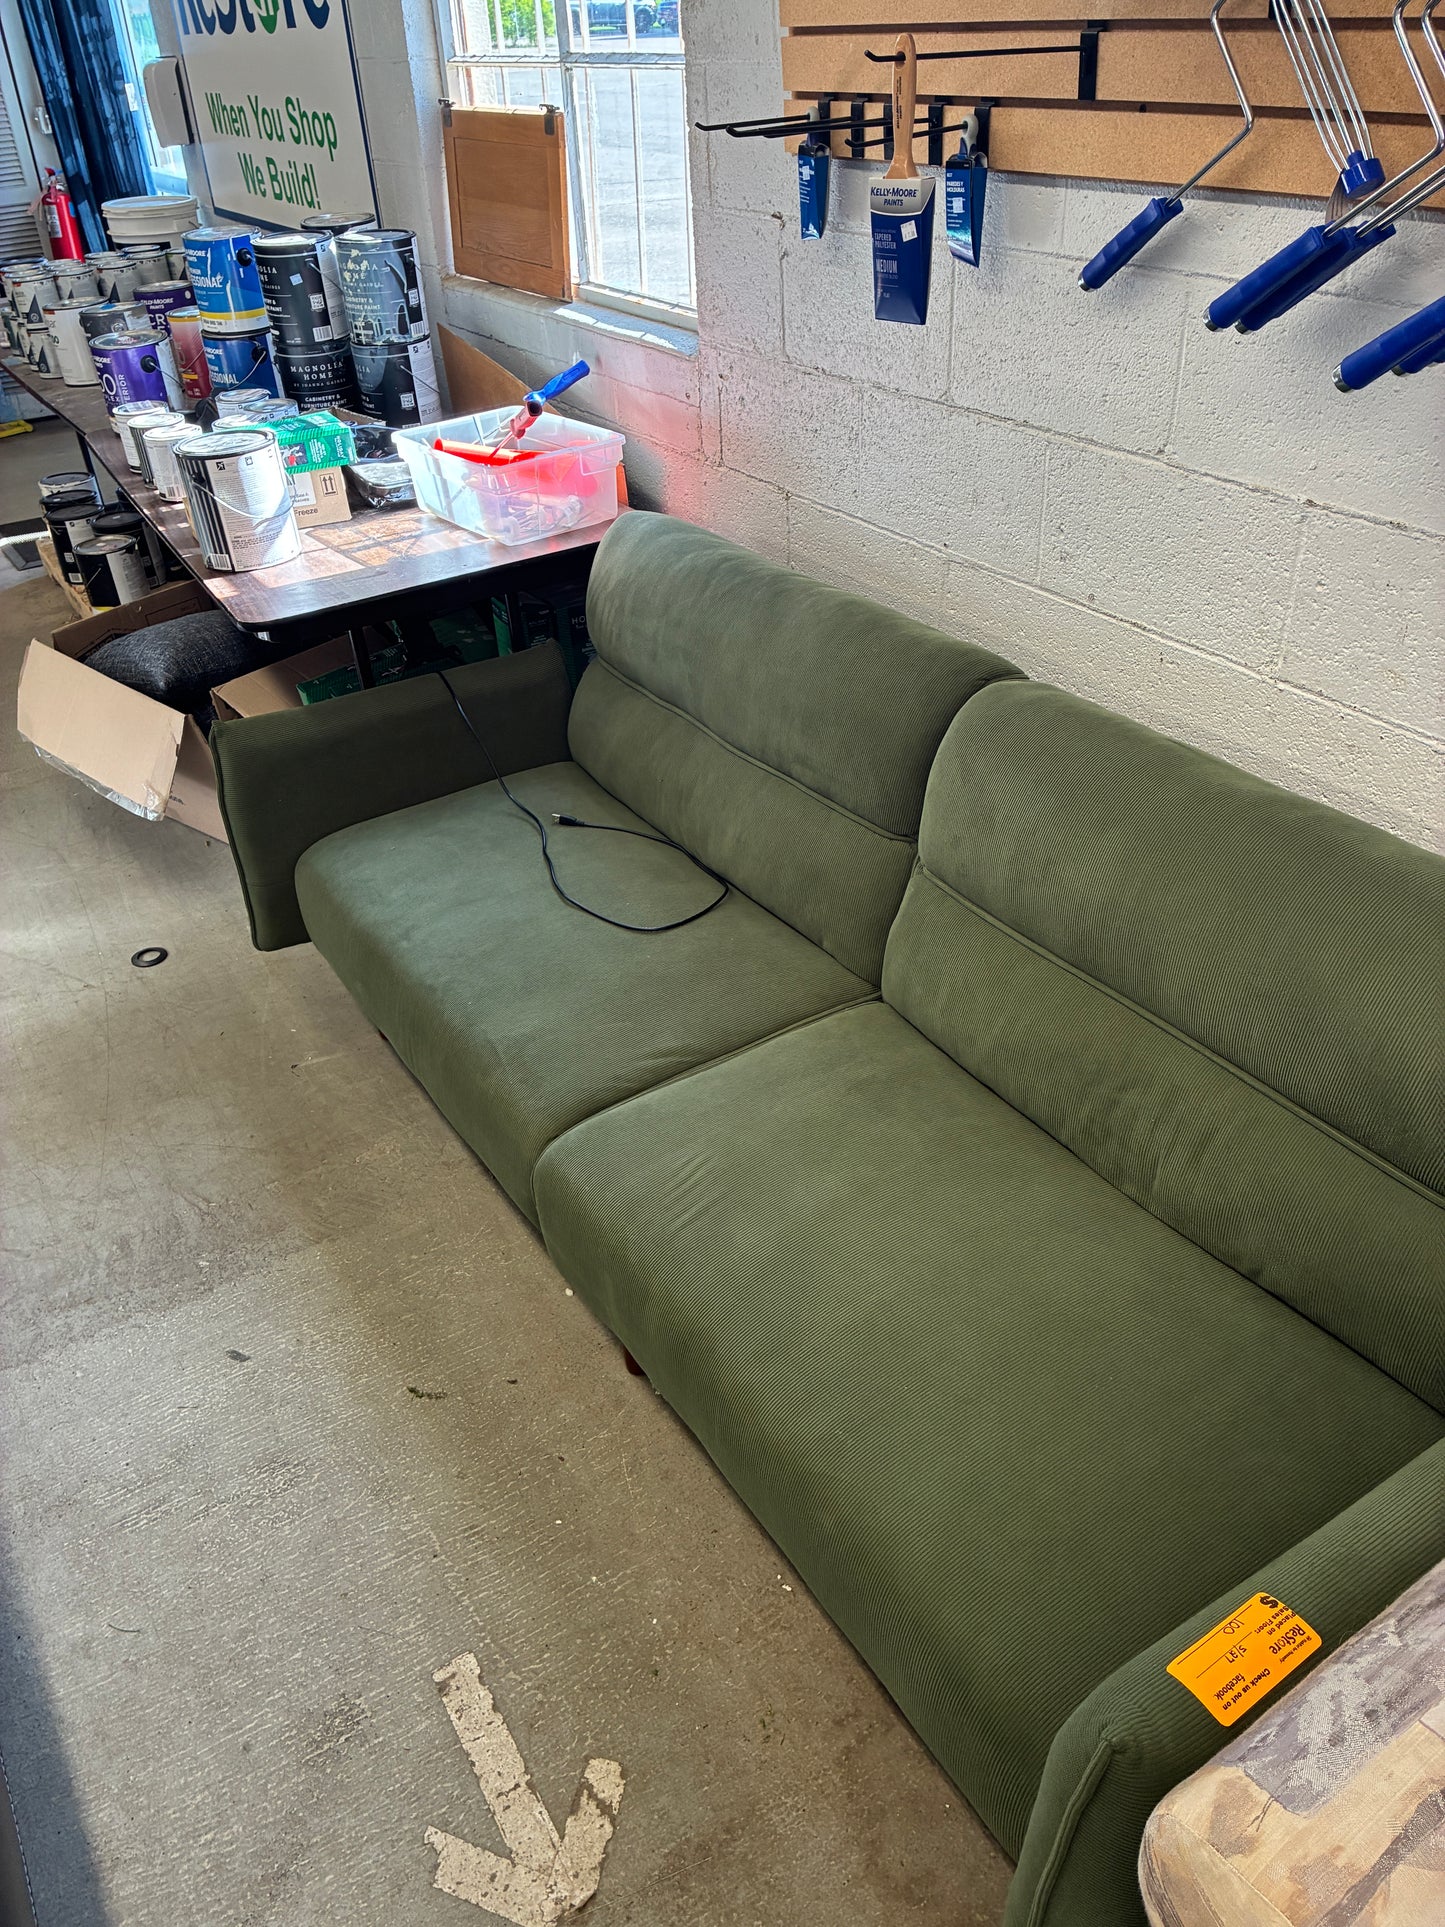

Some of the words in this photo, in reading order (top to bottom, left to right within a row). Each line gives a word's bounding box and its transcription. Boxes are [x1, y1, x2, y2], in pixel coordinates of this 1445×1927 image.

[205, 92, 251, 138] When
[247, 94, 285, 142] You
[285, 96, 338, 162] Shop
[237, 152, 267, 198] We
[265, 156, 321, 210] Build!
[870, 186, 919, 198] KELLY-MOORE
[883, 198, 904, 206] PAINTS
[874, 233, 892, 241] TAPERED
[874, 241, 897, 250] POLYESTER
[876, 258, 898, 274] MEDIUM
[191, 274, 223, 288] ESSIONAL
[290, 361, 344, 373] MAGNOLIA
[303, 371, 334, 381] HOME
[300, 401, 331, 409] FURNITURE
[331, 398, 348, 406] PAINT
[304, 395, 336, 403] CABINETRY
[1259, 1595, 1279, 1609] $
[1271, 1605, 1289, 1620] Sales
[1223, 1618, 1245, 1635] 100
[1254, 1618, 1274, 1634] Floor:
[1275, 1611, 1297, 1630] Placed
[1267, 1627, 1276, 1636] on
[1269, 1624, 1306, 1654] ReStore
[1250, 1668, 1270, 1686] Check
[1213, 1673, 1246, 1701] facebook
[1242, 1684, 1251, 1693] us
[1231, 1691, 1243, 1704] out
[1222, 1701, 1232, 1710] on
